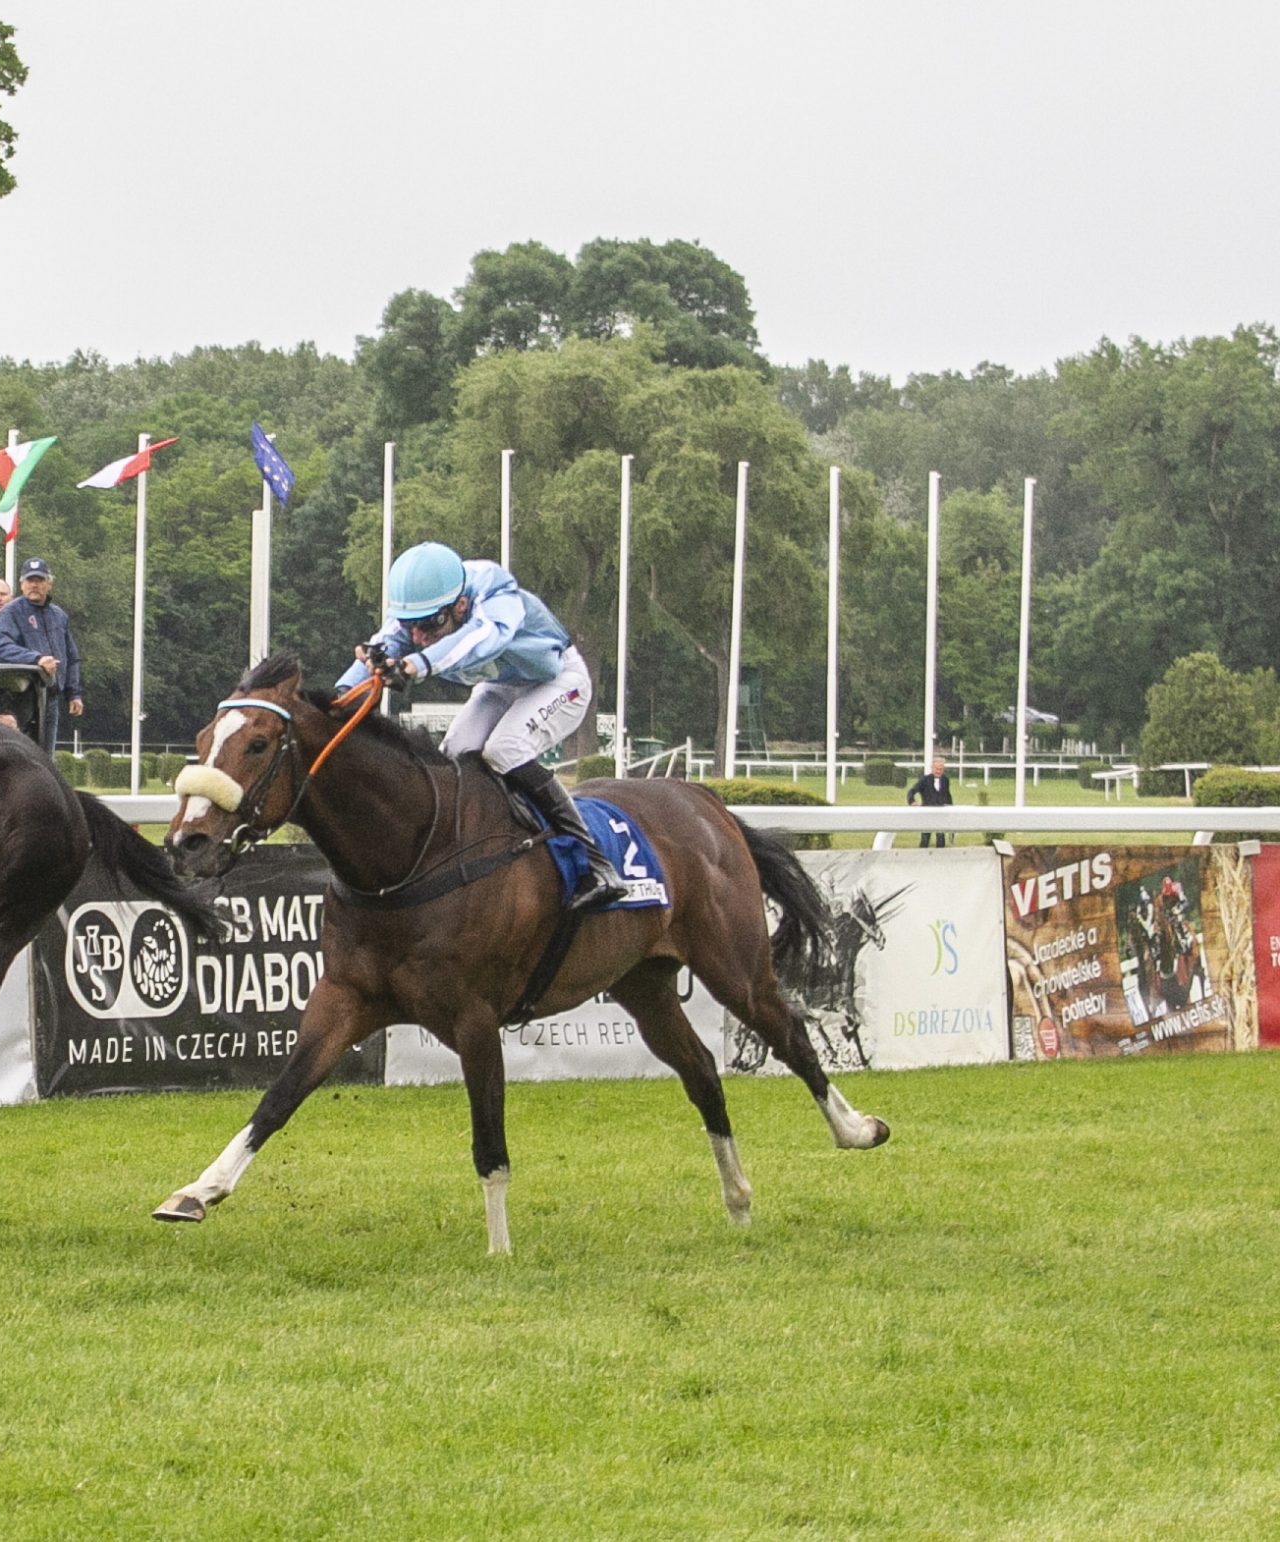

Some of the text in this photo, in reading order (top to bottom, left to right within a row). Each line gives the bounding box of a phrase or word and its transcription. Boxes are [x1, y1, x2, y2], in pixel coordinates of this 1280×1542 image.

[608, 818, 648, 877] 2
[1011, 852, 1113, 916] VETIS
[196, 895, 324, 944] SB MAT
[1087, 927, 1097, 945] a
[195, 951, 324, 1014] DIABO
[68, 1036, 134, 1066] MADE
[145, 1035, 167, 1061] IN
[176, 1032, 246, 1060] CZECH
[519, 1023, 588, 1047] CZECH
